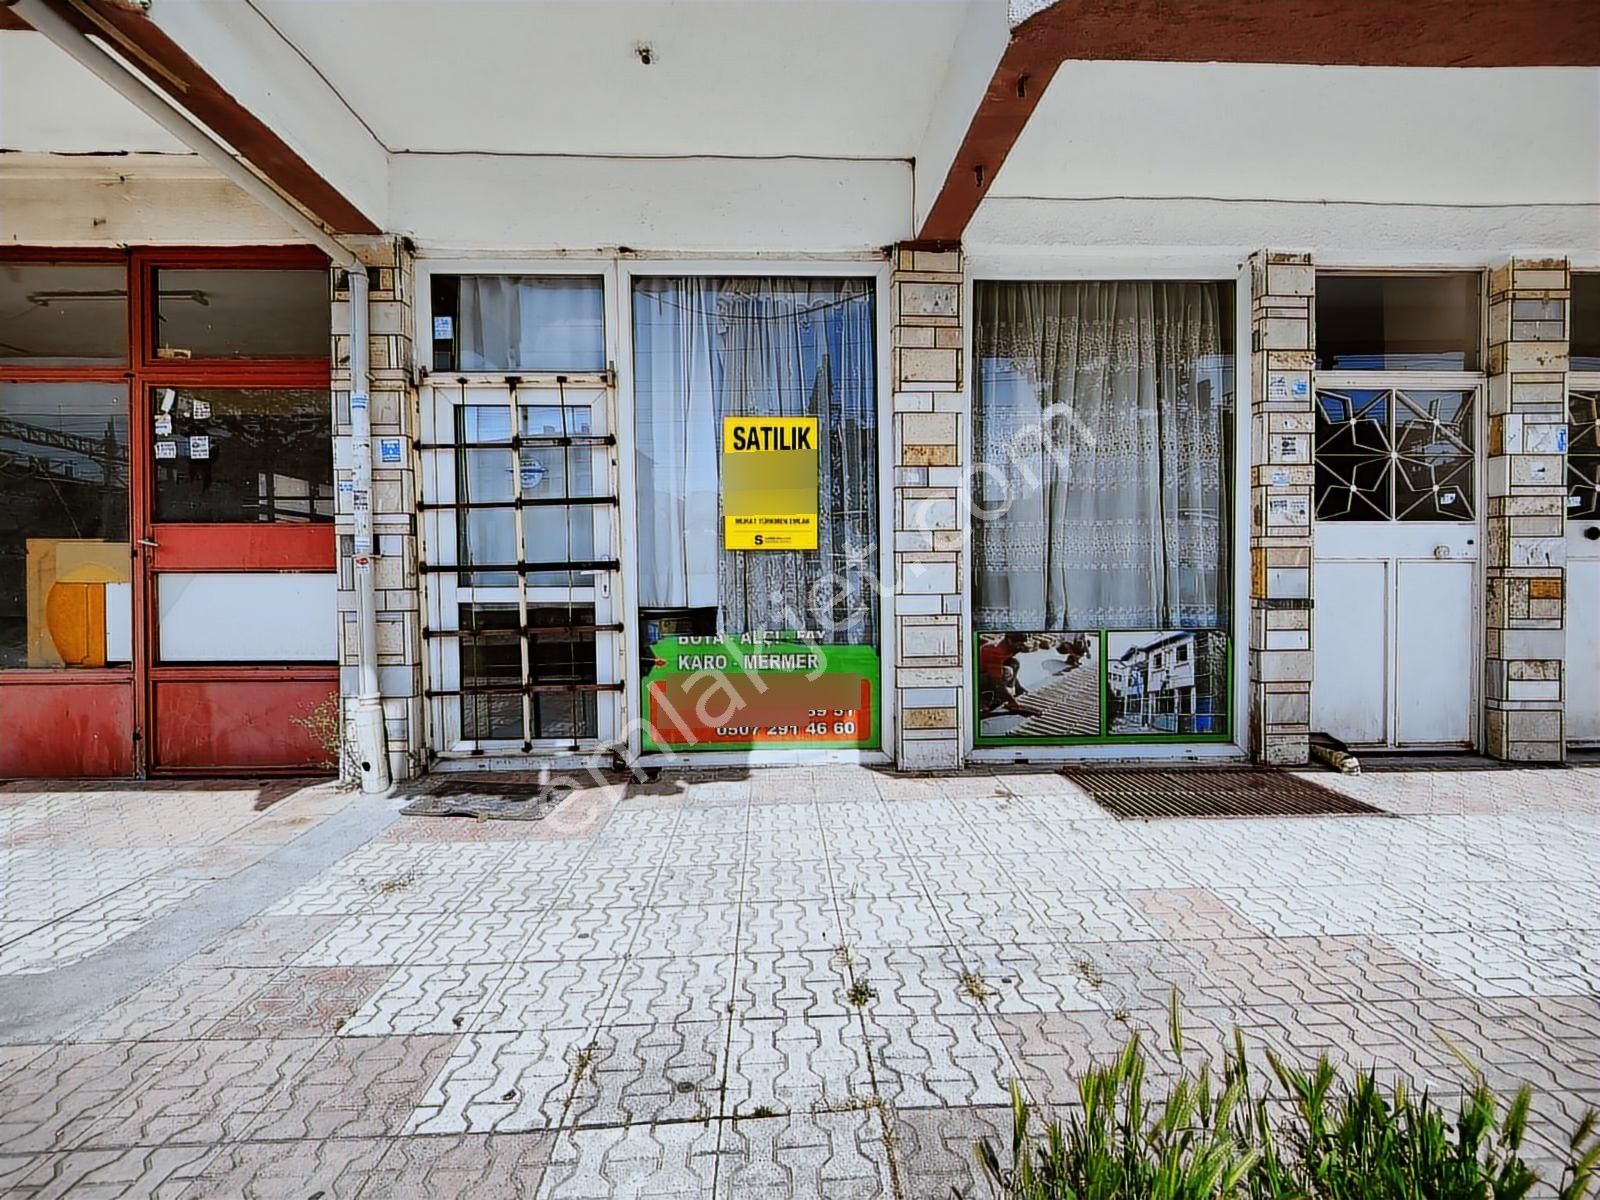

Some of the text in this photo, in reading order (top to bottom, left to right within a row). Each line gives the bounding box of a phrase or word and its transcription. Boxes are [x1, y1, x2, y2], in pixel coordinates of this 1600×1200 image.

[733, 426, 811, 450] SATILIK
[678, 653, 819, 670] KARO MERMER
[805, 721, 828, 735] 46
[833, 721, 855, 735] 60
